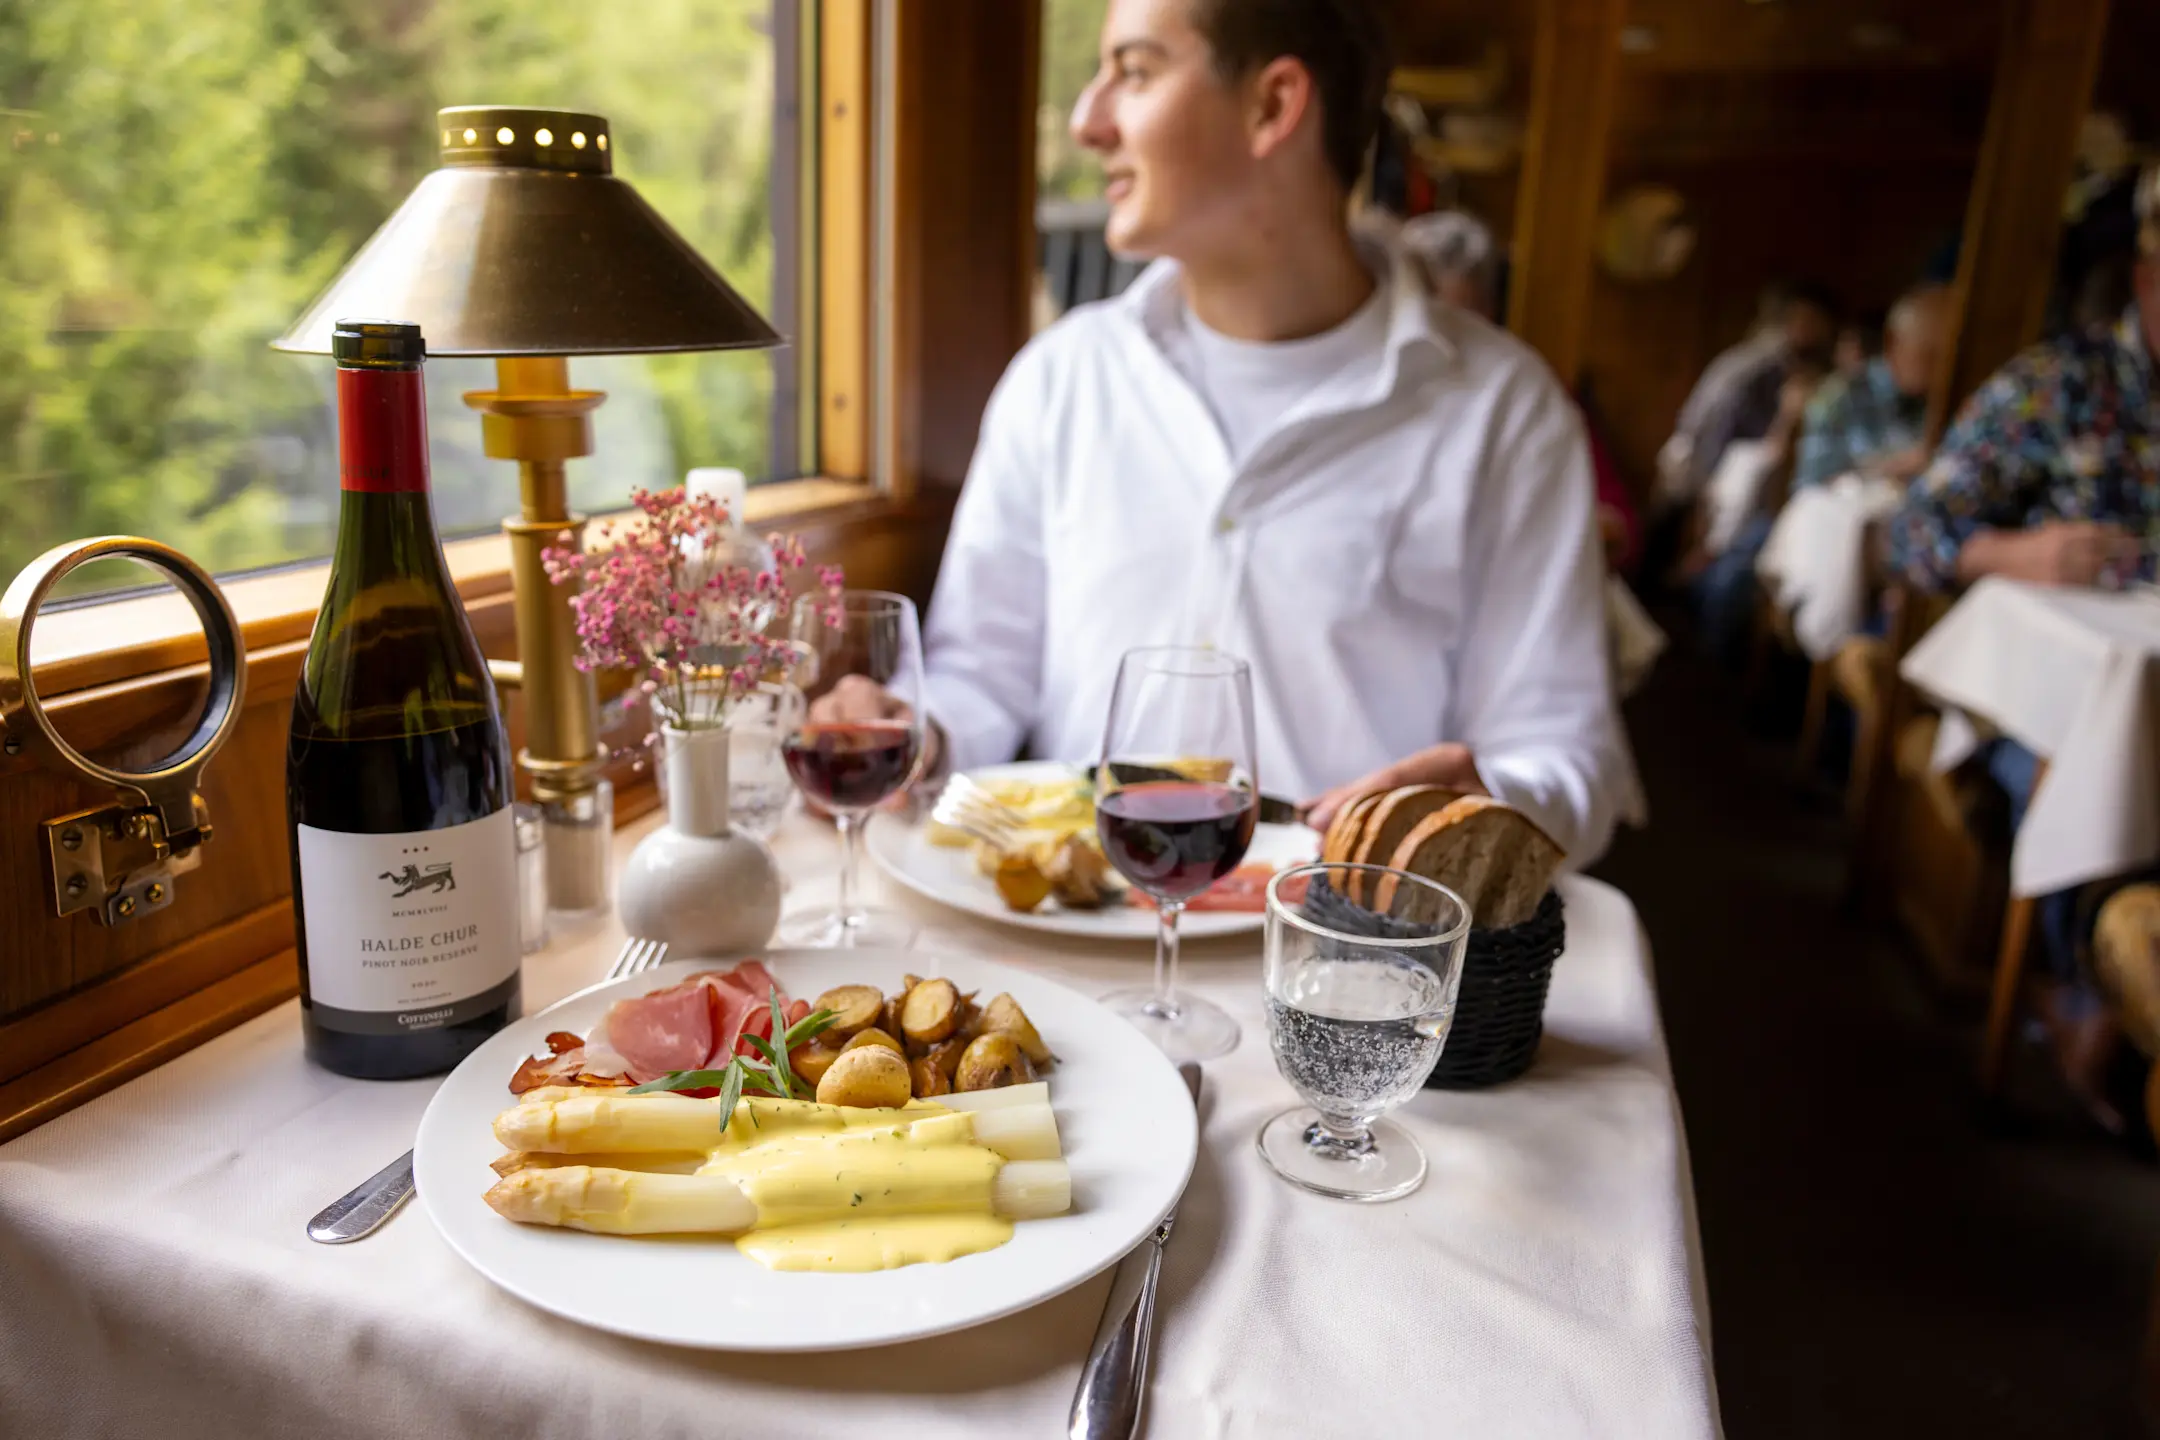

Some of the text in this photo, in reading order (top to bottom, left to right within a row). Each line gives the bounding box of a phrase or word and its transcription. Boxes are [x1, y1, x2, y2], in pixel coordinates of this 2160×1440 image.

[361, 924, 478, 952] HALDE CHUR
[362, 959, 396, 968] PINOT
[401, 956, 429, 967] NOIR
